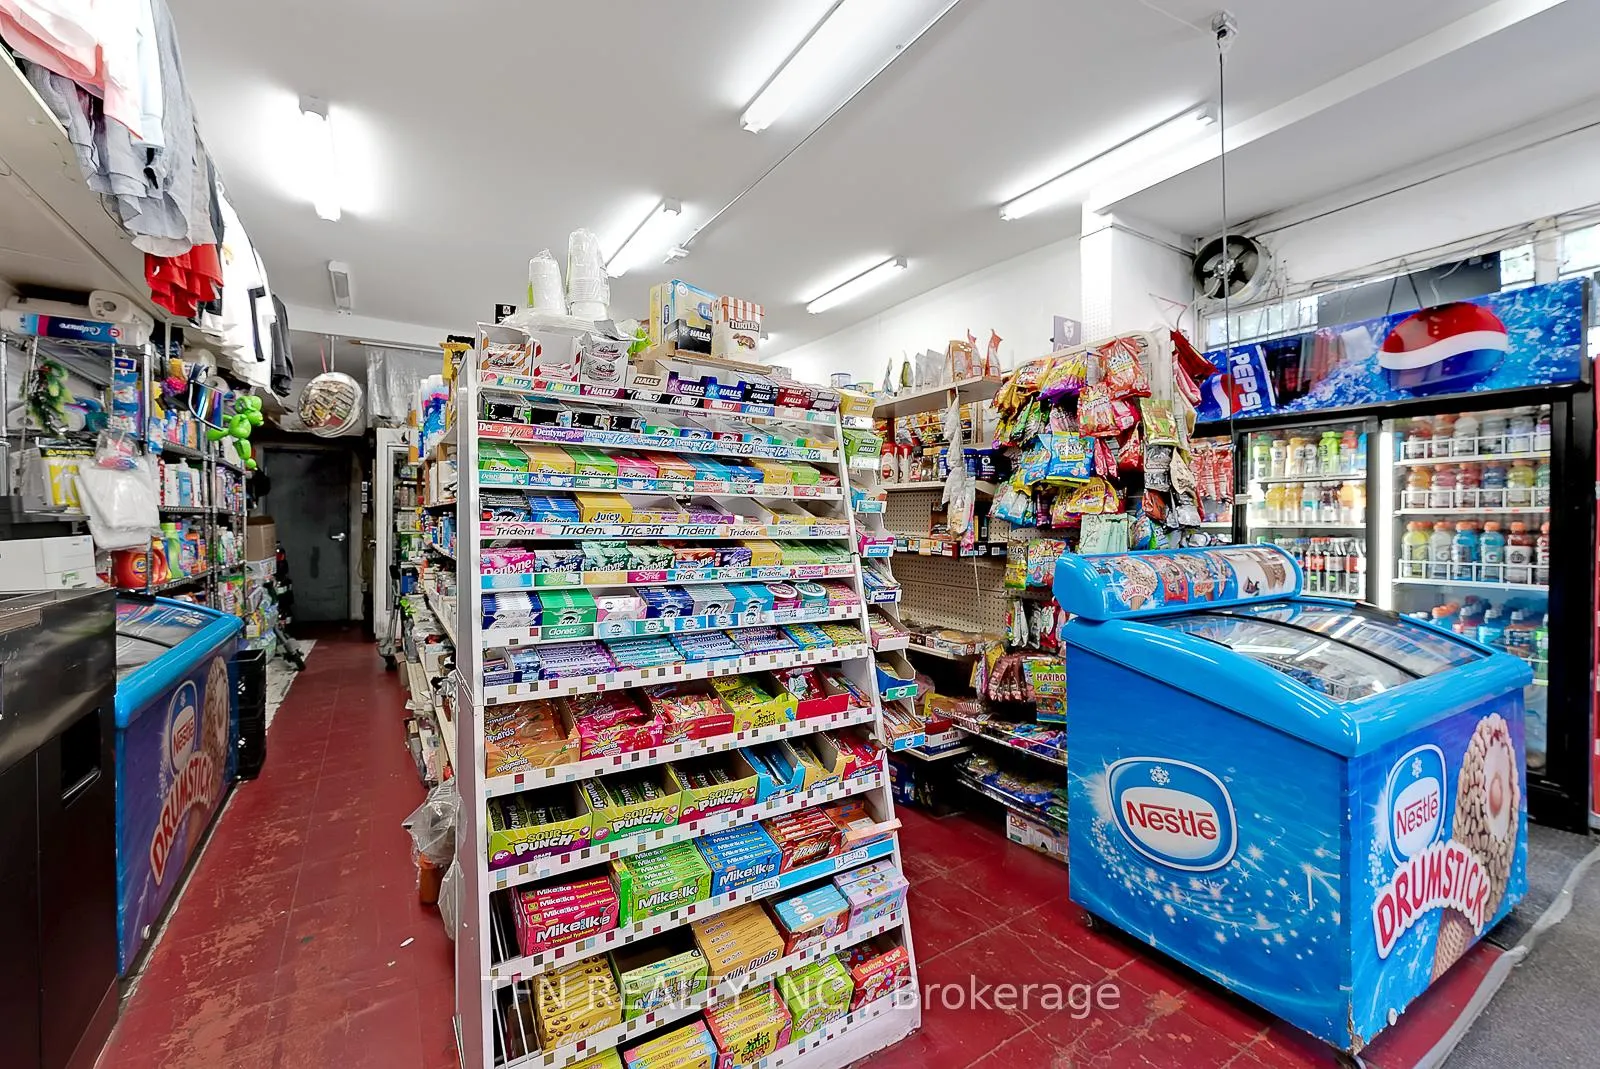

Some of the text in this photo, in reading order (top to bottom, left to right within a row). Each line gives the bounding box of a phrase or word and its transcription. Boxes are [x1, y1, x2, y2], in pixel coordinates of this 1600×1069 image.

[732, 320, 760, 332] TURTLES
[690, 329, 711, 340] HALLS
[635, 377, 660, 387] HALLS
[1229, 352, 1262, 411] PEPSI
[591, 386, 616, 397] HALLS
[681, 385, 704, 395] HALLS
[719, 389, 743, 398] HALLS
[751, 392, 770, 401] HALLS
[784, 396, 803, 404] HALLS
[748, 405, 770, 415] HALLS
[535, 429, 566, 441] Dentyne
[658, 437, 674, 447] Ice
[677, 439, 715, 451] Dentyne Ice
[718, 442, 753, 454] Dentyne Ice
[775, 447, 788, 457] Ice
[808, 449, 821, 459] Ice
[594, 512, 621, 522] Juicy
[496, 527, 535, 536] Trident
[677, 524, 717, 536] Trident
[819, 529, 841, 537] Trident
[636, 571, 662, 582] Stride
[1121, 584, 1154, 601] DRUMSTICK
[548, 627, 577, 637] Clorets
[1037, 673, 1066, 682] HARIBO
[942, 731, 959, 742] DAVID
[708, 787, 735, 799] SOUR
[698, 792, 743, 811] PUNCH
[152, 756, 213, 878] DRUMSTICK
[624, 808, 654, 820] SOUR
[1396, 790, 1439, 839] Nestlé
[612, 811, 664, 832] PUNCH
[1009, 816, 1028, 829] Dole
[1126, 800, 1217, 840] Nestlé
[528, 829, 562, 843] SOUR
[515, 834, 573, 856] PUNCH
[718, 841, 734, 851] Mike
[726, 856, 743, 866] Mike
[719, 868, 751, 887] Mike
[537, 886, 558, 896] Mike
[540, 897, 560, 907] Mike
[638, 891, 679, 910] Mike
[1377, 848, 1488, 949] DRUMSTICK
[655, 901, 674, 912] Original
[543, 908, 565, 919] Mike
[536, 913, 611, 943] Mike Ike
[552, 934, 573, 944] Tropical
[750, 948, 778, 971] Duds
[743, 1036, 770, 1053] SOUR
